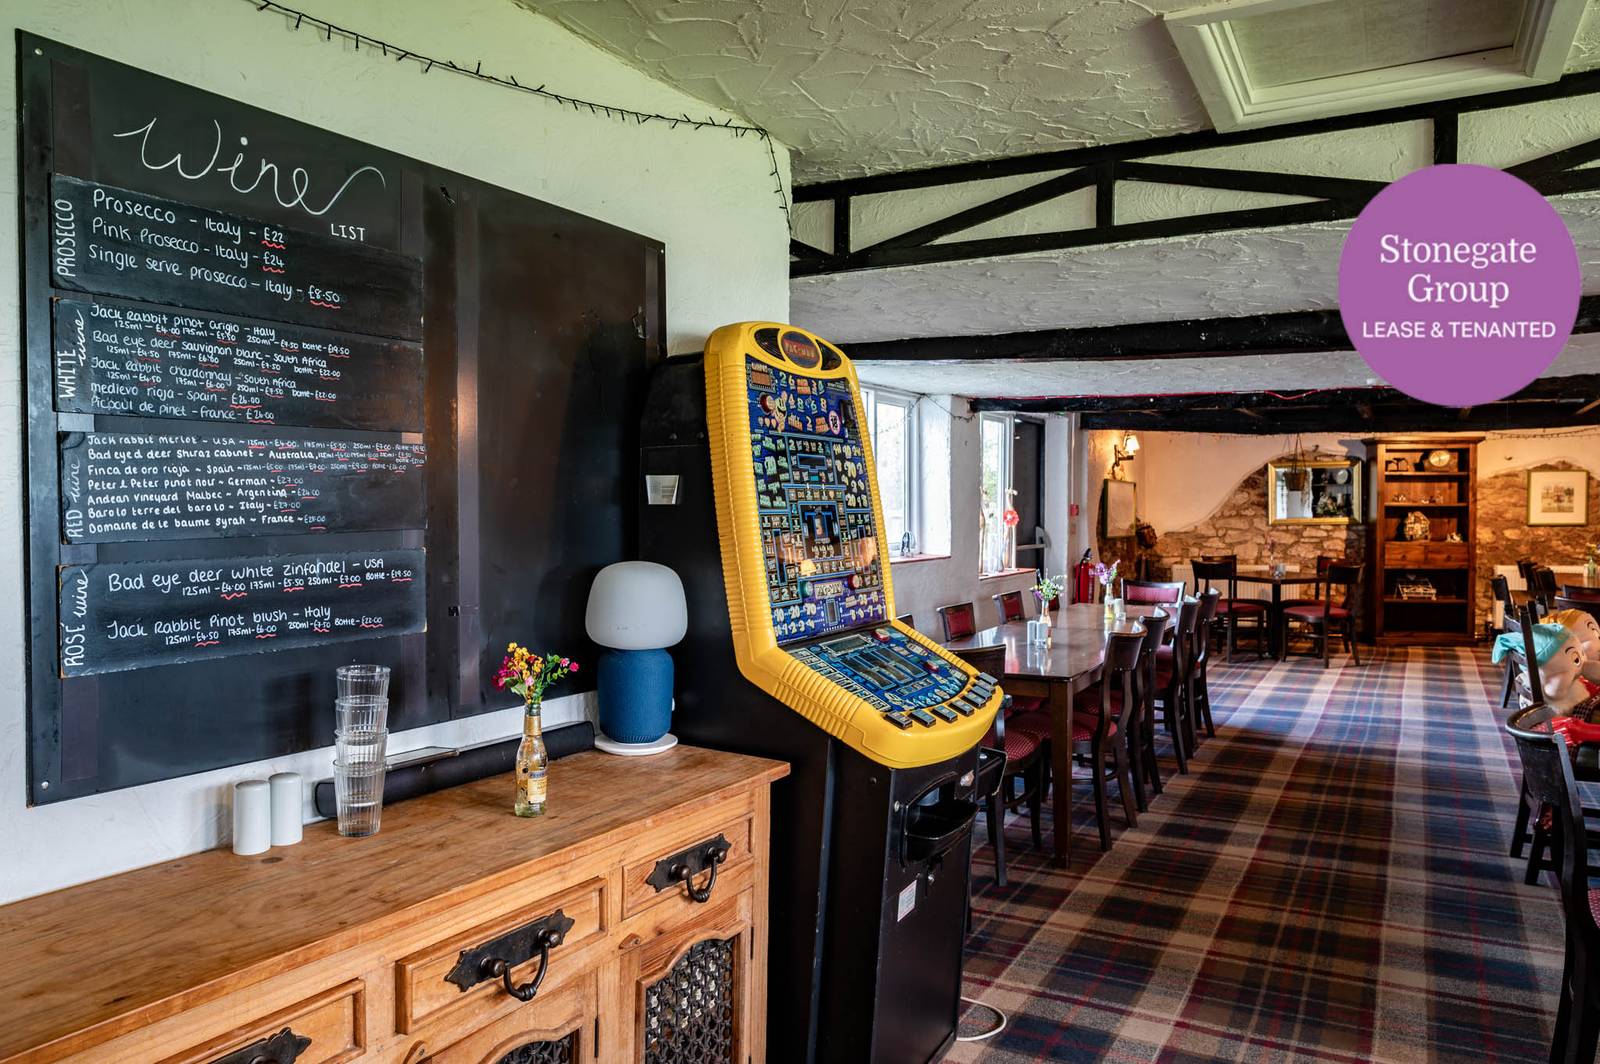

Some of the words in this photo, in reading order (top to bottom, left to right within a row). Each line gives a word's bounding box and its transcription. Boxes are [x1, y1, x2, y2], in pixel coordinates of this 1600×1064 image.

[113, 117, 386, 215] Wine
[93, 188, 176, 224] Prosecco
[205, 217, 241, 245] Italy
[263, 227, 285, 244] £22
[55, 199, 76, 277] PROSECCO
[92, 217, 131, 240] Pink
[215, 244, 249, 268] Italy
[262, 252, 285, 267] £24
[330, 223, 366, 242] LIST
[89, 244, 138, 276] Single
[145, 255, 182, 276] serve
[190, 265, 247, 289] prosecco
[265, 279, 292, 301] Italy
[90, 303, 122, 320] Jack
[127, 311, 168, 324] Rabbit
[173, 316, 204, 330] pinot
[254, 327, 275, 342] Italy
[114, 321, 142, 330] 125ml
[156, 324, 181, 336] £4.00
[183, 328, 208, 338] 175ml
[246, 335, 271, 346] 250ml
[93, 330, 118, 344] Bad
[123, 335, 147, 349] eye
[151, 337, 177, 348] deer
[236, 348, 263, 361] blanc
[302, 356, 327, 368] Africa
[106, 346, 130, 355] 125ml
[137, 348, 160, 358] £4.50
[168, 351, 192, 361] 175ml
[233, 358, 255, 368] 250ml
[57, 350, 76, 398] WHITE
[91, 357, 120, 371] Jack
[126, 362, 163, 374] Rabbit
[272, 378, 297, 389] Africa
[107, 372, 131, 381] 125ml
[176, 377, 197, 387] 175ml
[237, 384, 259, 393] 250ml
[147, 386, 174, 402] rioja
[139, 401, 155, 413] de
[159, 403, 187, 417] pinet
[88, 435, 116, 445] Jack
[119, 436, 153, 445] rabbit
[213, 437, 235, 446] USA
[88, 450, 111, 460] Bad
[114, 450, 143, 463] eyed
[147, 449, 172, 459] deer
[88, 465, 121, 476] Finca
[125, 465, 138, 475] de
[141, 466, 159, 475] oro
[162, 463, 190, 477] rioja
[88, 479, 116, 490] Peter
[131, 479, 159, 489] Peter
[164, 478, 192, 489] pinot
[228, 477, 267, 487] German
[88, 495, 130, 506] Andean
[186, 490, 223, 500] Malbec
[237, 486, 287, 500] Argentina
[88, 507, 127, 519] Barolo
[132, 505, 160, 515] terre
[163, 504, 181, 515] del
[187, 502, 225, 513] barolo
[239, 502, 265, 513] Italy
[66, 510, 83, 537] RED
[88, 522, 138, 534] Domaine
[141, 519, 156, 530] de
[175, 518, 211, 528] baume
[262, 514, 295, 524] France
[108, 573, 145, 592] Bad
[152, 574, 182, 594] eye
[189, 568, 223, 583] deer
[283, 560, 346, 577] Zinfandel
[364, 558, 384, 569] USA
[182, 585, 211, 596] 125ml
[221, 583, 246, 594] £4.00
[250, 581, 275, 590] 175ml
[283, 578, 305, 588] £5.50
[307, 576, 332, 586] 250ml
[72, 568, 89, 618] wine
[107, 620, 148, 640] Jack
[154, 618, 201, 634] Rabbit
[253, 609, 288, 624] blush
[304, 606, 331, 621] Italy
[165, 634, 191, 645] 125ml
[228, 628, 251, 637] 175ml
[288, 621, 309, 630] 250ml
